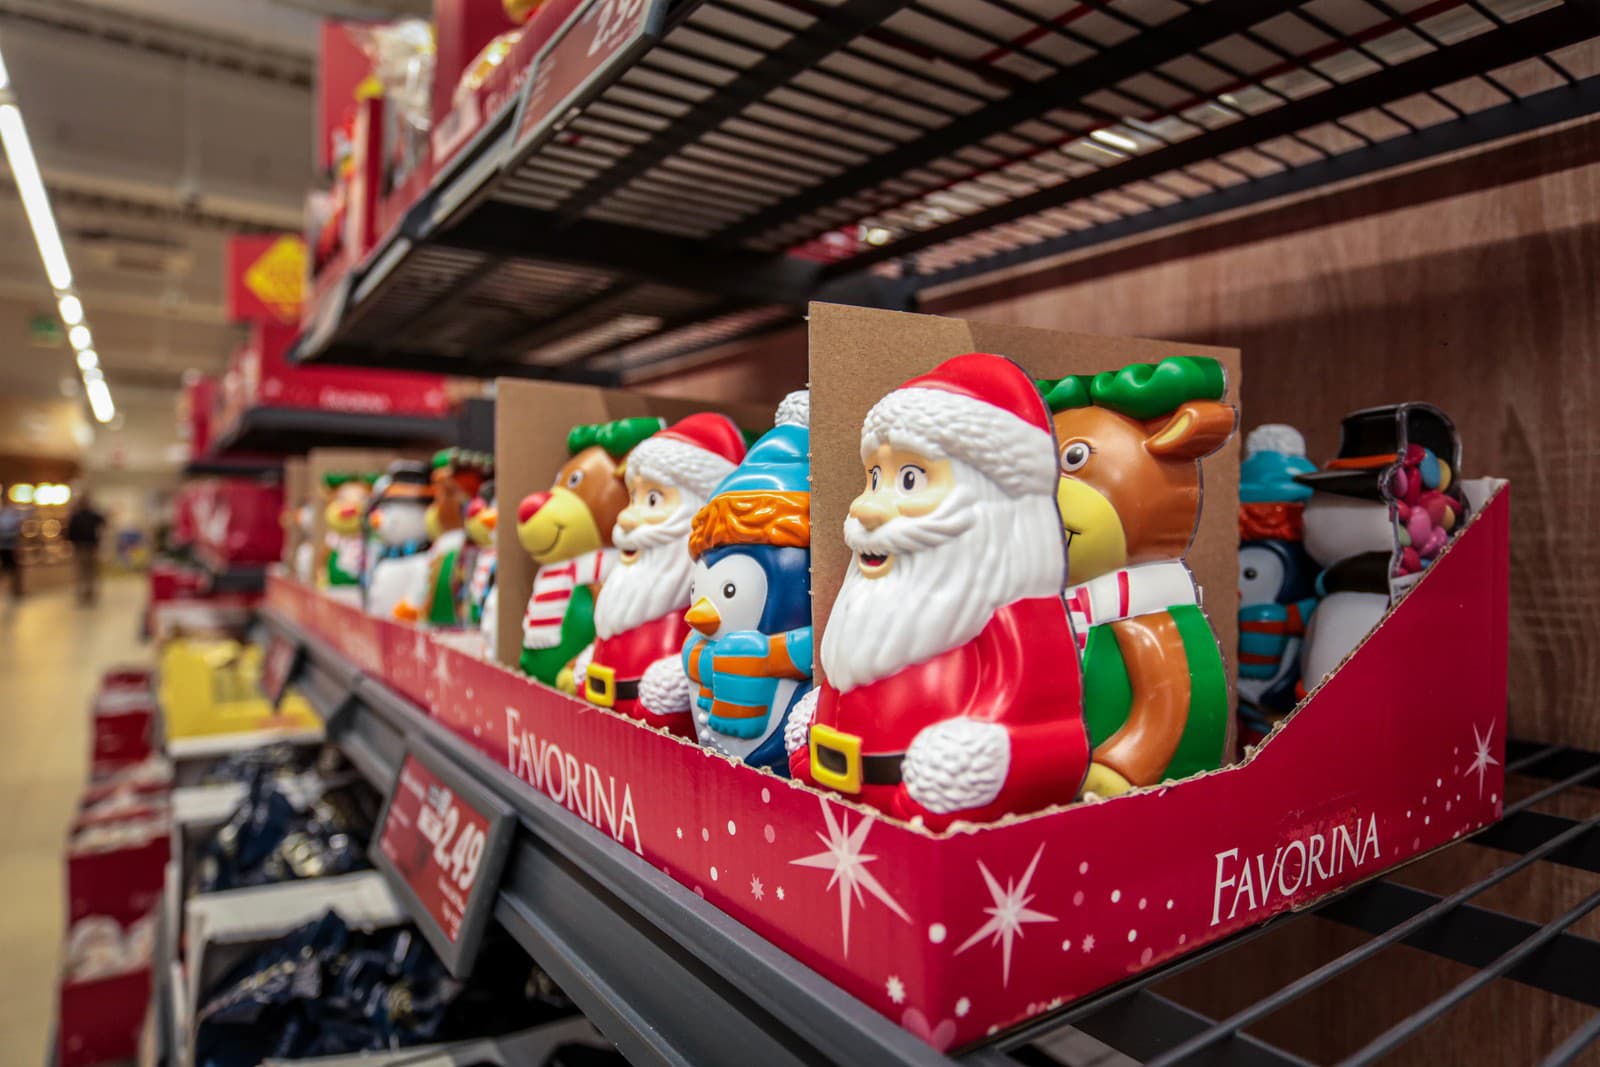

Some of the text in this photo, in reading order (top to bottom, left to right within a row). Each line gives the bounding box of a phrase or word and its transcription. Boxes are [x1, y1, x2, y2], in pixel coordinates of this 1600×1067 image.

[505, 706, 643, 856] FAVORINA
[434, 806, 486, 891] 2.49
[1210, 812, 1381, 926] FAVORINA
